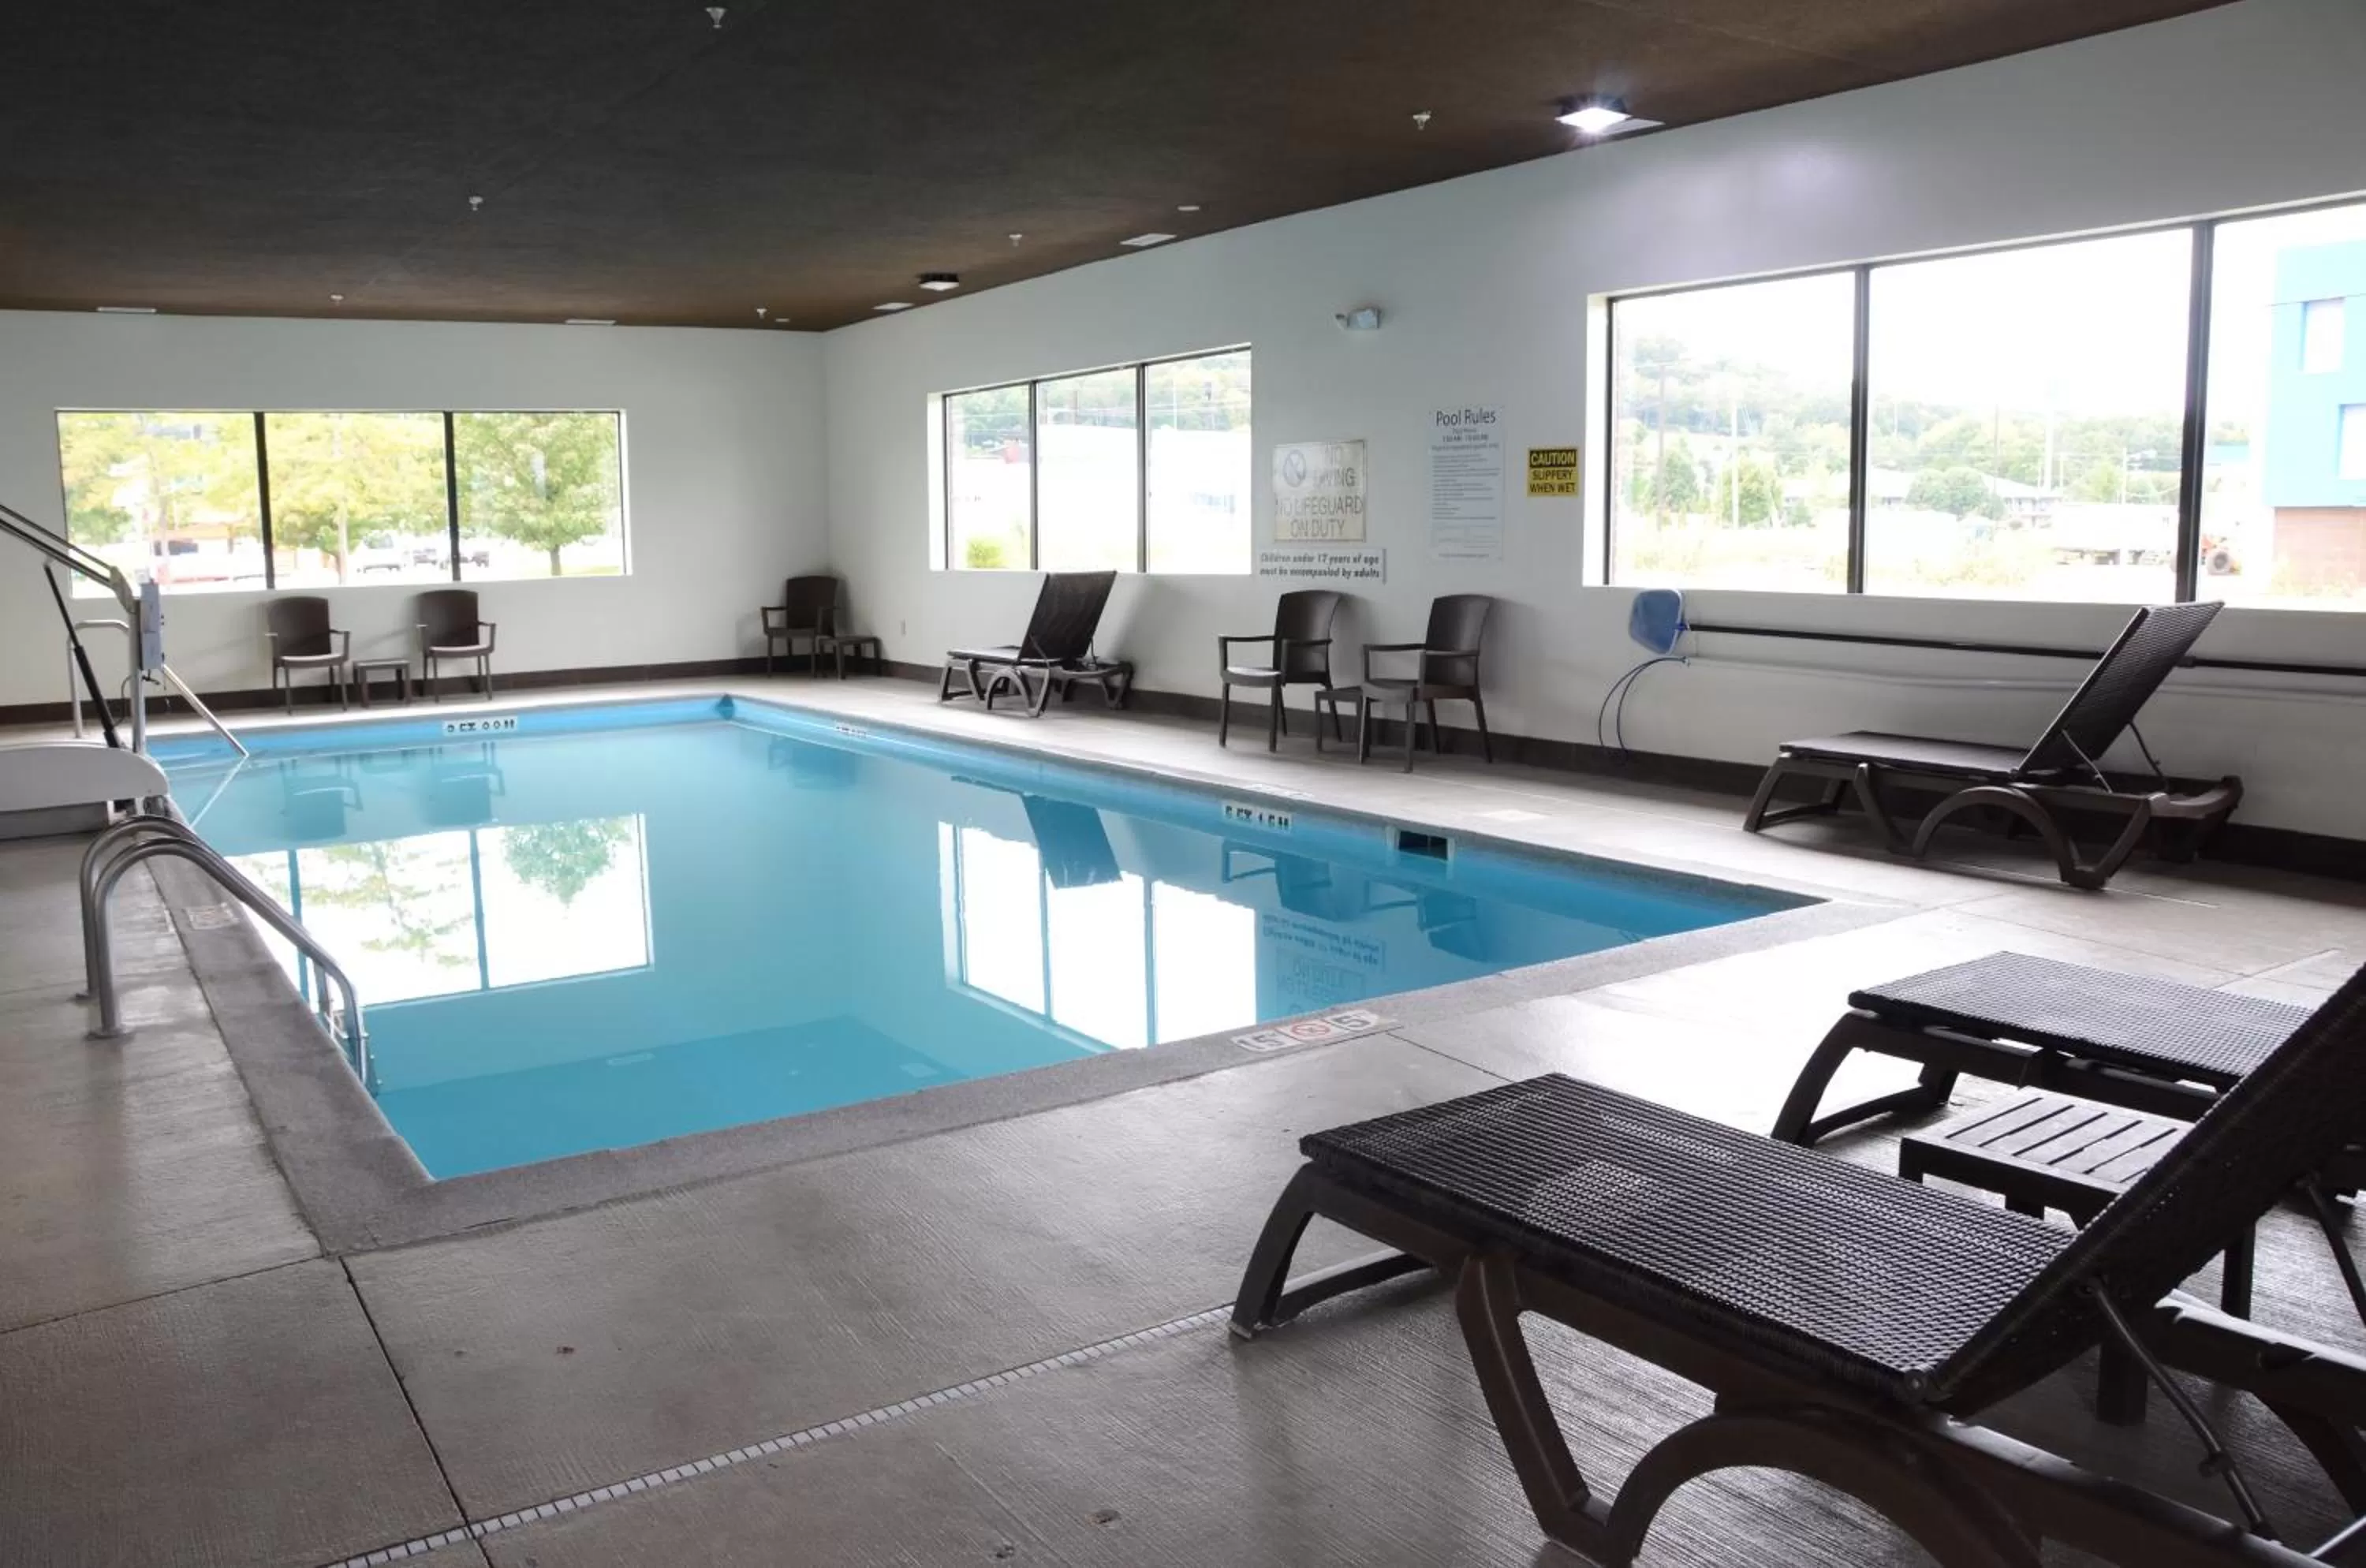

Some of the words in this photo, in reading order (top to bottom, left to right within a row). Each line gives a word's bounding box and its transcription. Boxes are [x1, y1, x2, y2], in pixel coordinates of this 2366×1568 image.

[1436, 409, 1461, 427] Pool
[1465, 407, 1496, 424] Rules
[1531, 451, 1575, 465] CAUTION
[1532, 469, 1573, 480] SLIPPERY
[1530, 482, 1555, 493] WHEN
[1558, 482, 1575, 493] WET
[1293, 495, 1364, 516] LIFEGUARD
[1312, 517, 1345, 537] DUTY
[1318, 553, 1327, 563] 17
[1353, 553, 1363, 563] of
[1342, 567, 1351, 580] by
[1353, 567, 1380, 578] adults
